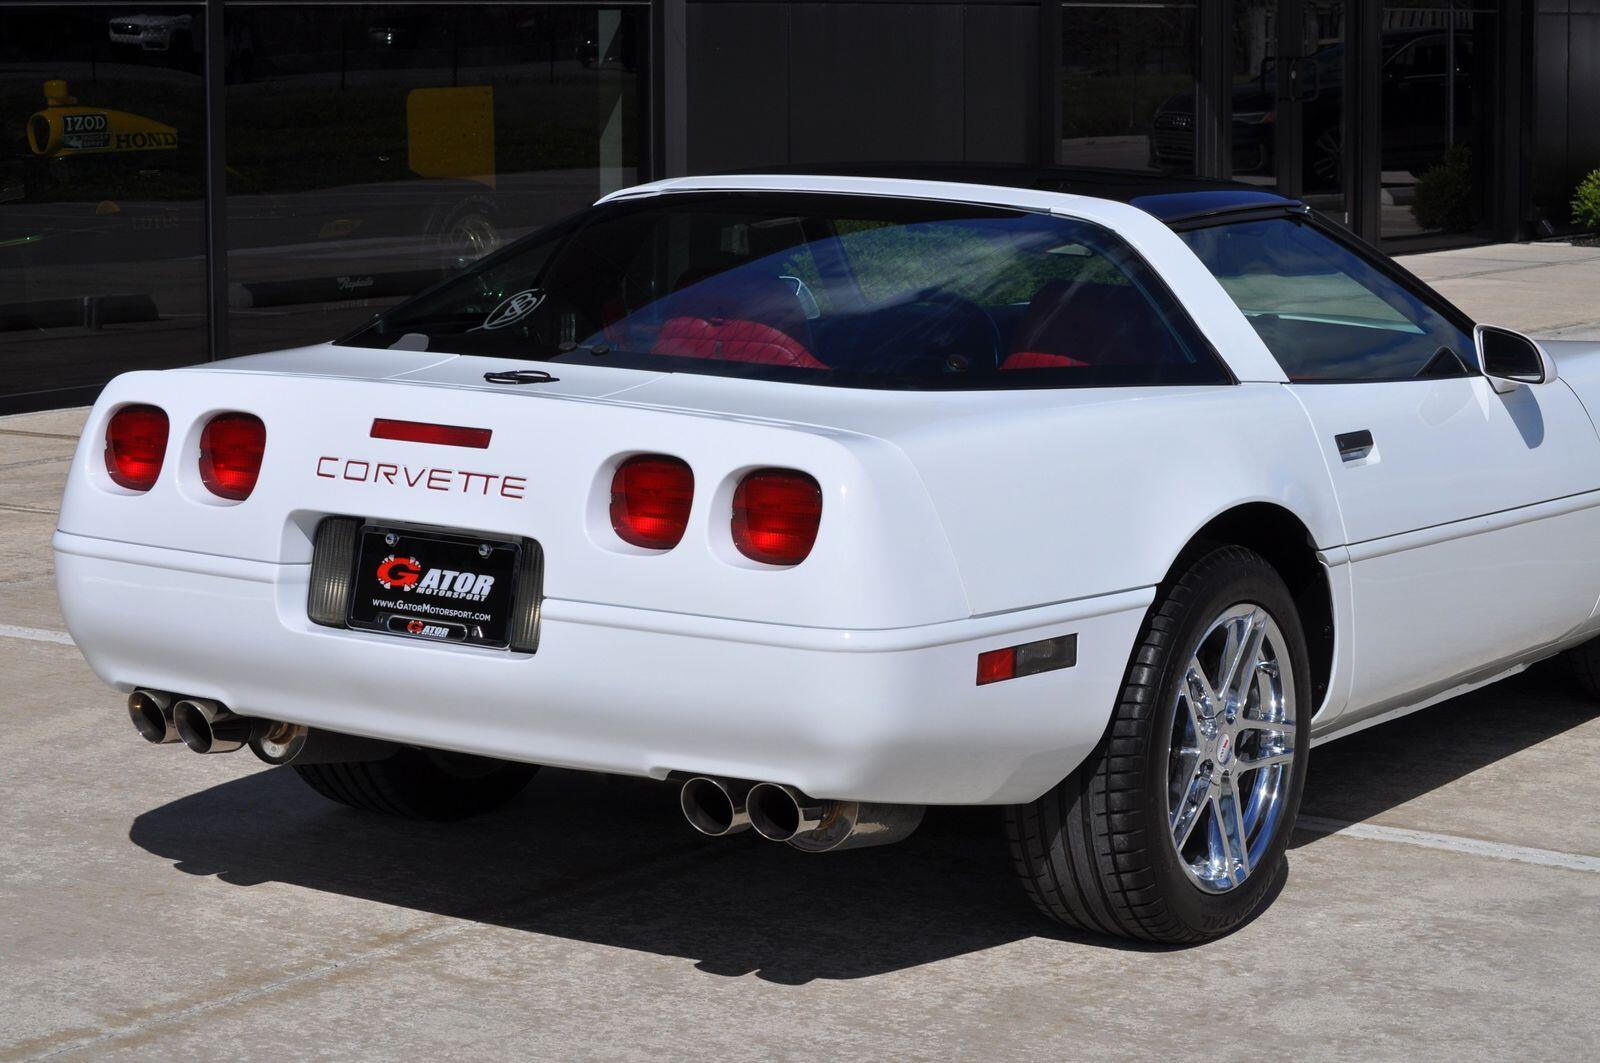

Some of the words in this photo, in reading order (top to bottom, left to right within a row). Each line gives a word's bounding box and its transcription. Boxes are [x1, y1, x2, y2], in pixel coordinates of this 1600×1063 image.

[65, 116, 106, 131] IZOD
[316, 456, 528, 500] CORVETTE
[376, 555, 496, 597] GATOR
[415, 586, 489, 602] MOTORSPORT
[407, 619, 450, 638] GATOR
